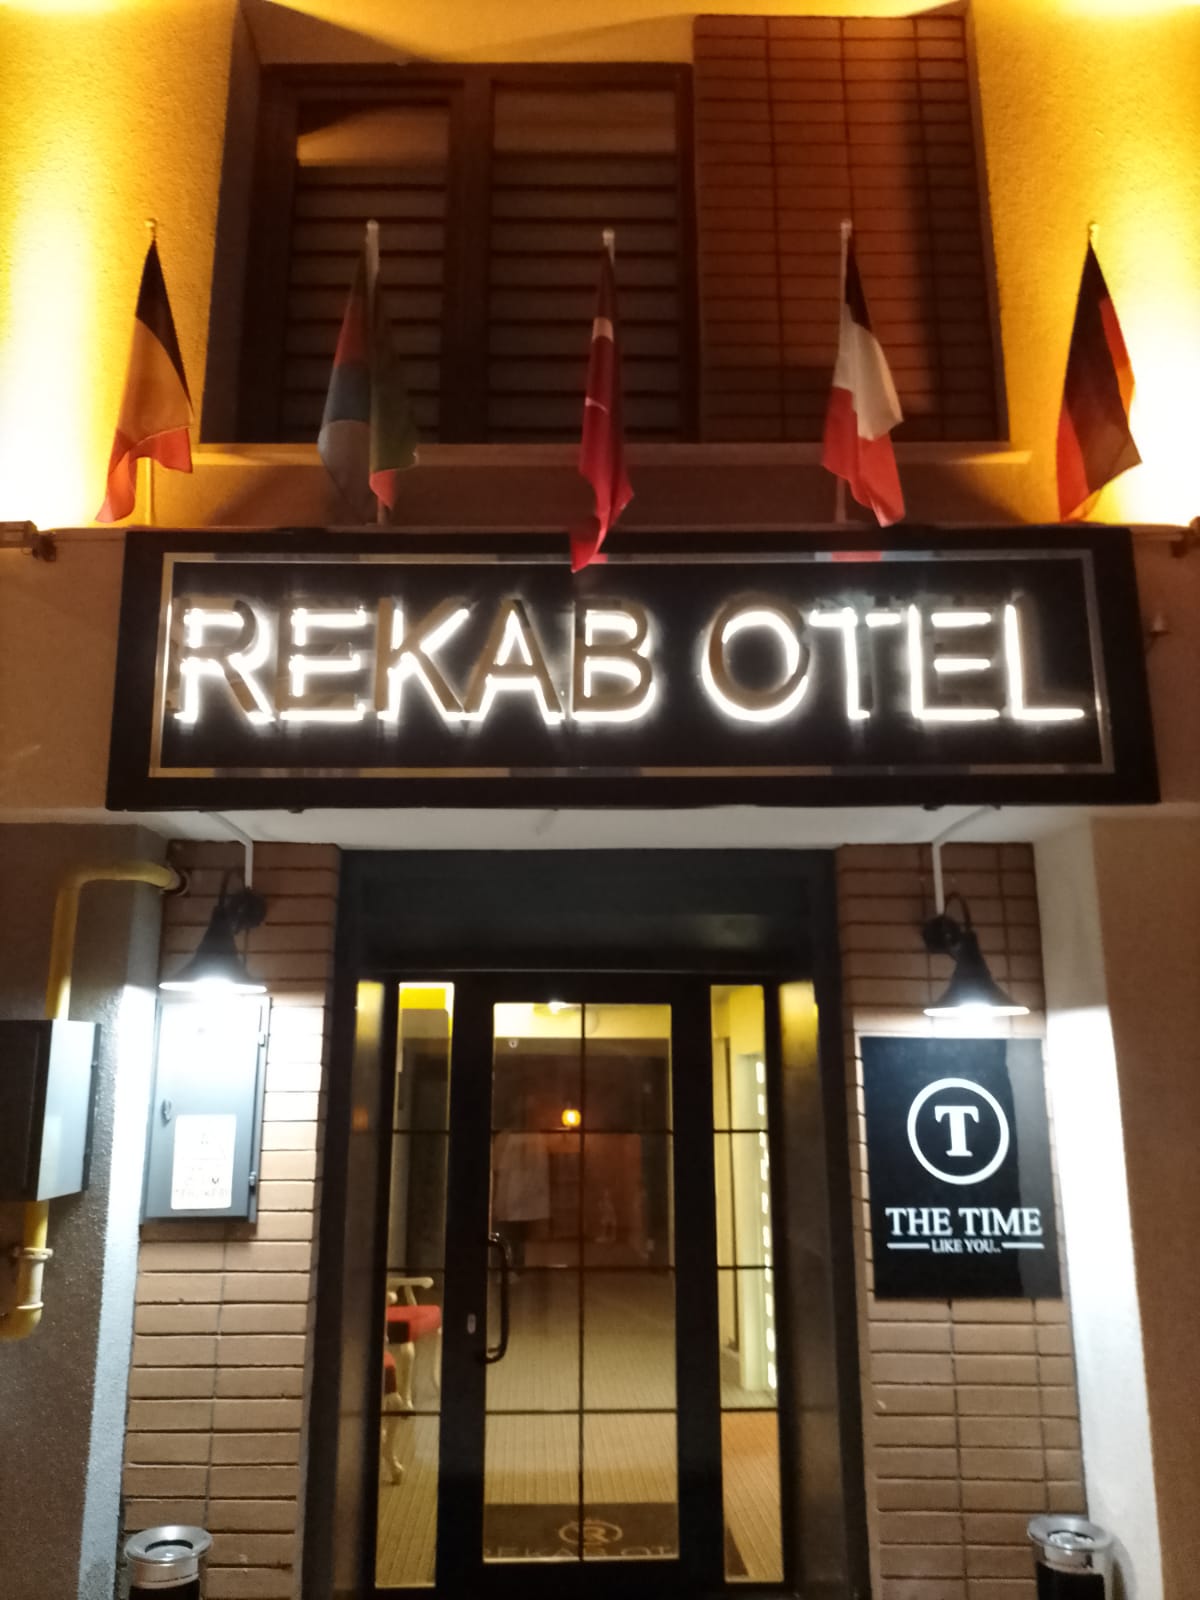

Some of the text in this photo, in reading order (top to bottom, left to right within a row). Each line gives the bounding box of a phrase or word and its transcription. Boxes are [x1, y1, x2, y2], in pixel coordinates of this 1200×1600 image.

[172, 594, 1086, 724] REKAB OTEL
[934, 1105, 979, 1157] T
[885, 1207, 1043, 1236] THE TIME
[931, 1238, 963, 1254] LIKE
